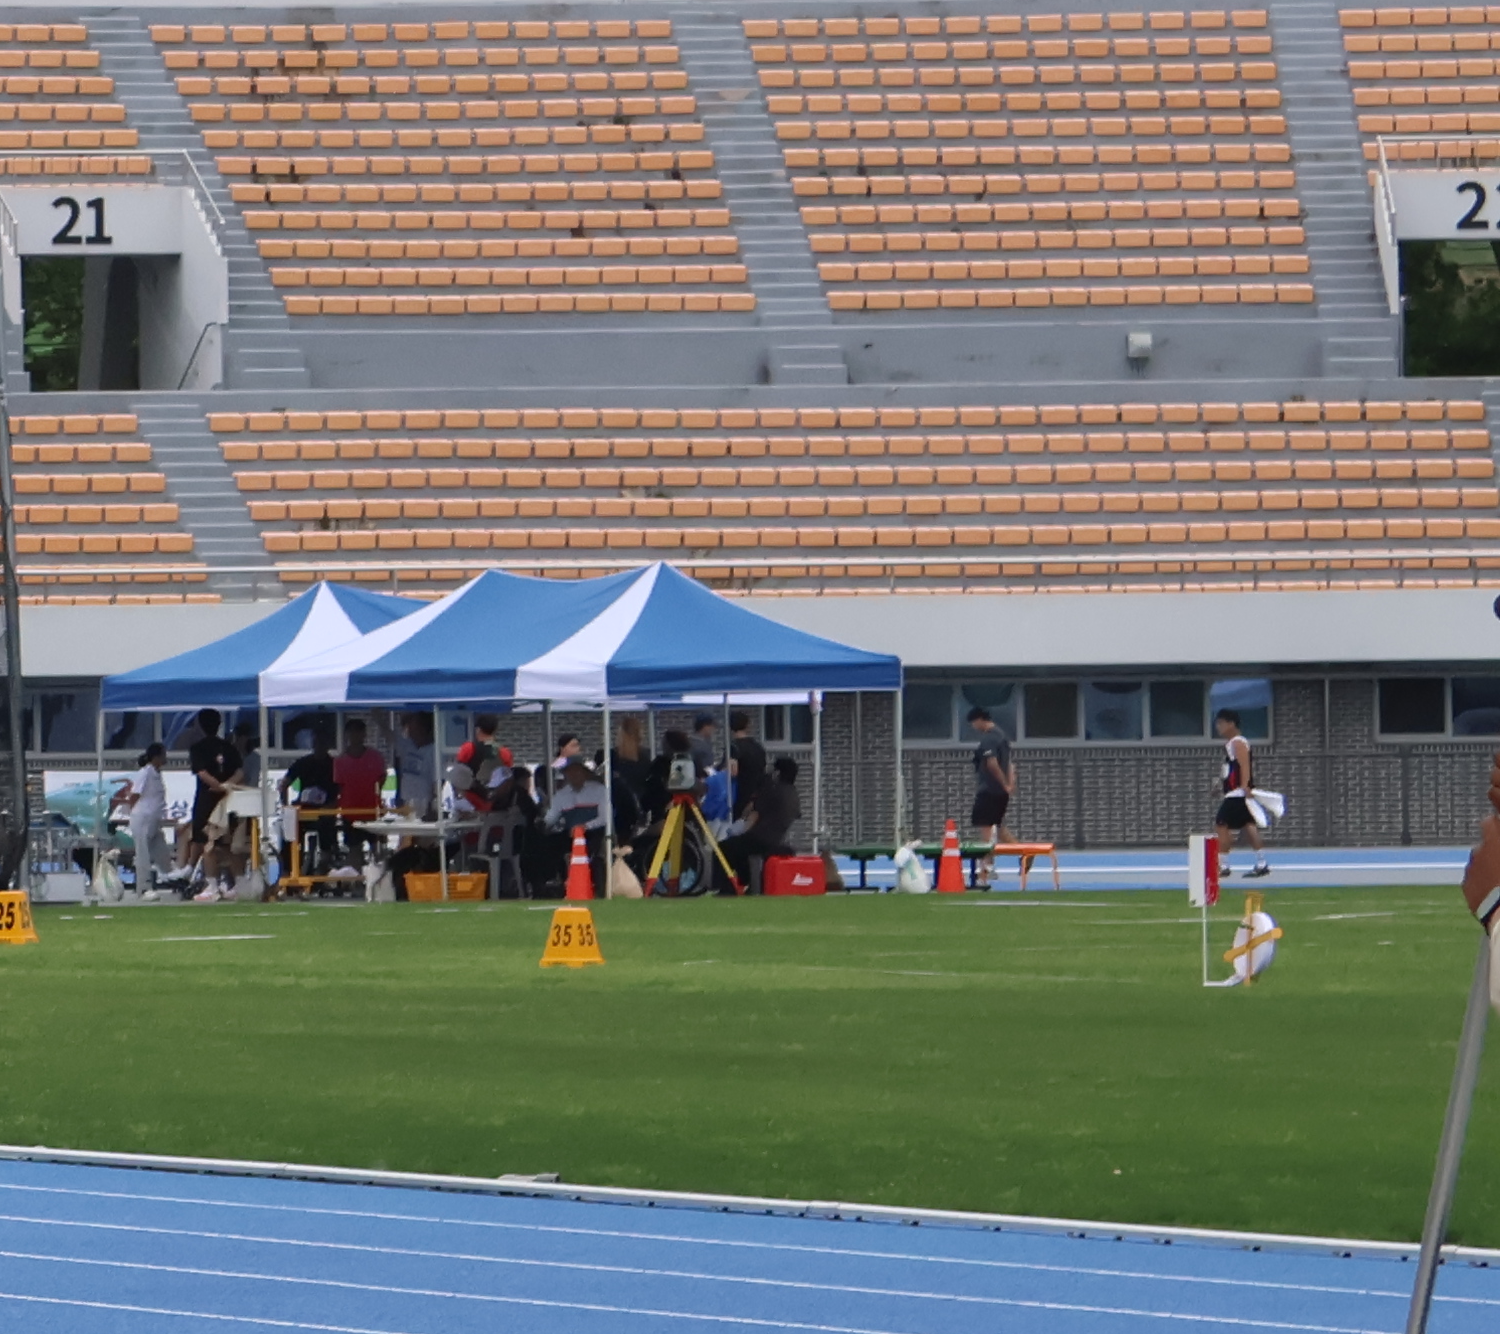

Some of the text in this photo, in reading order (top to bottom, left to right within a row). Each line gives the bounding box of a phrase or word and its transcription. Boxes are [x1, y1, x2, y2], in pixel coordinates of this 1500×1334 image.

[51, 195, 113, 245] 21
[1456, 181, 1500, 230] 2
[552, 923, 572, 947] 35
[577, 923, 594, 947] 35
